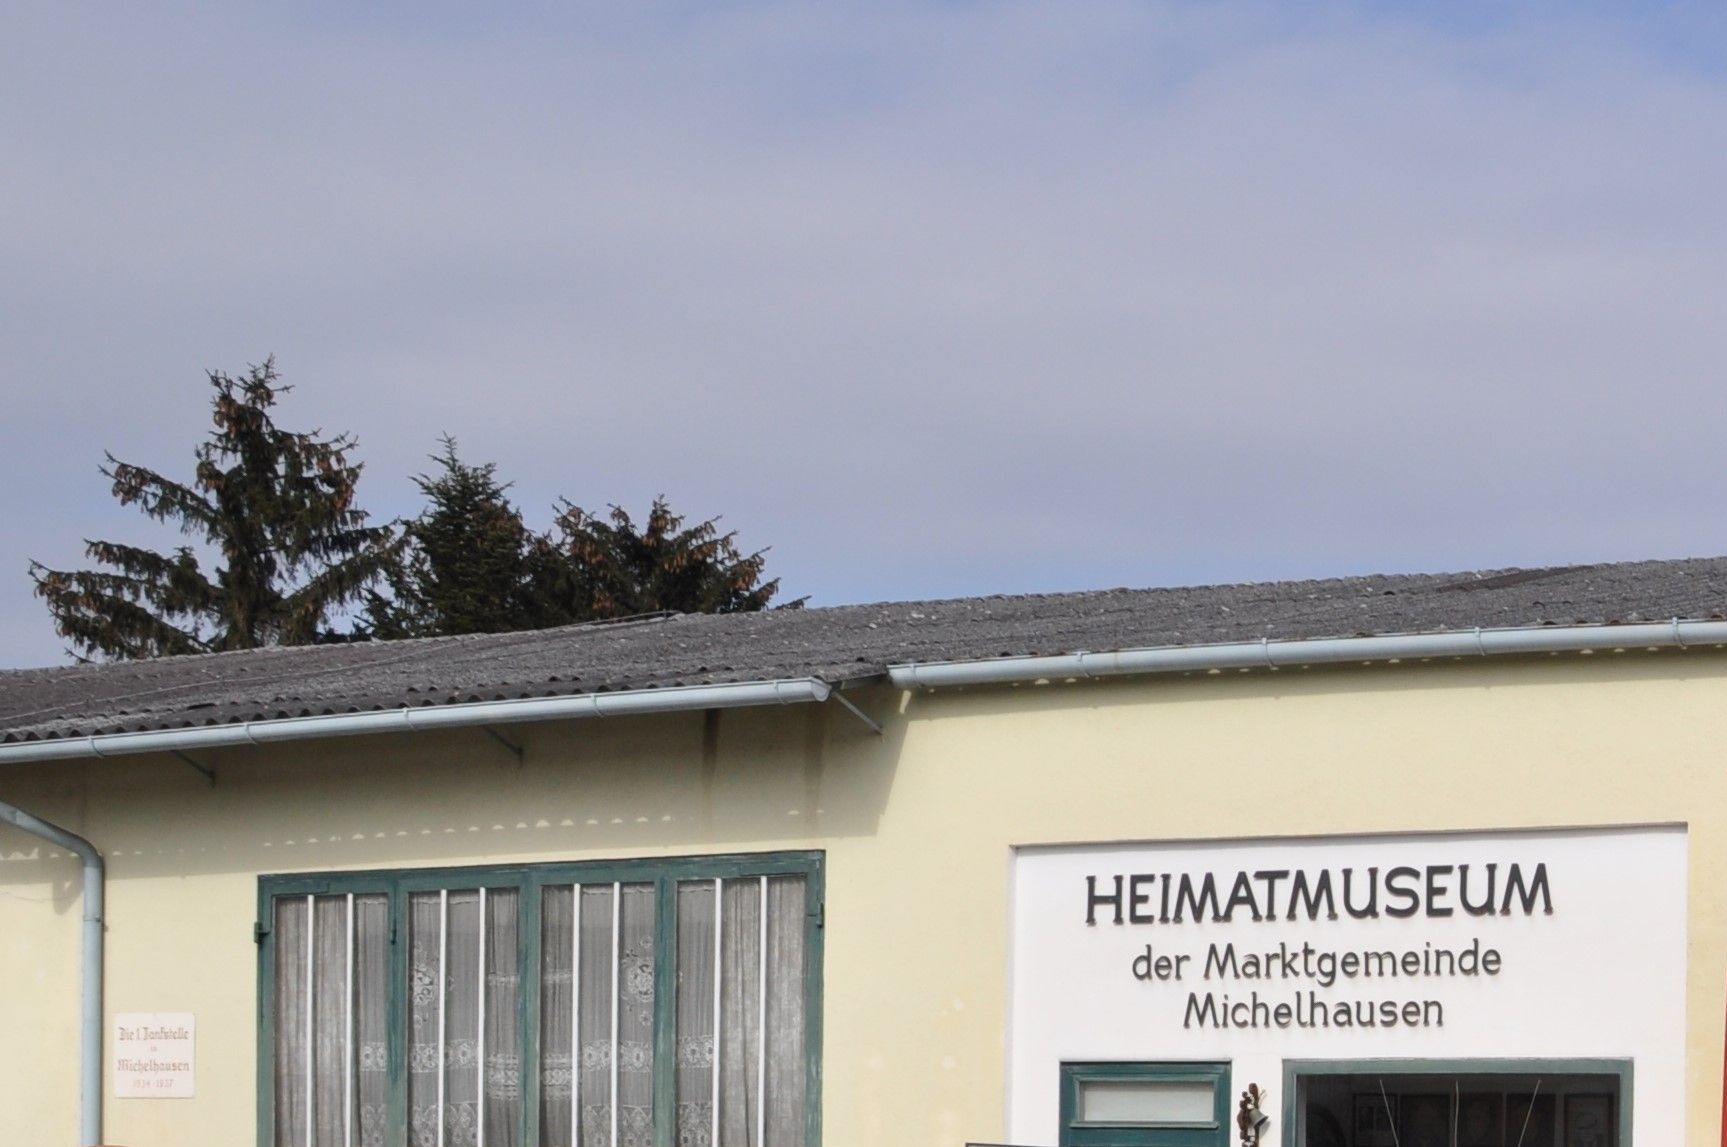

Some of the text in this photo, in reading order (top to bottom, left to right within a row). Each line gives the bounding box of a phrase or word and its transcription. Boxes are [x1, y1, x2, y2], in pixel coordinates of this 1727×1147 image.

[1086, 863, 1553, 926] HEIMATMUSEUM
[1133, 938, 1501, 987] der Marktgemeinde
[1184, 991, 1442, 1028] Michelhausen
[118, 1026, 134, 1041] Die
[117, 1059, 190, 1074] Michelhausen
